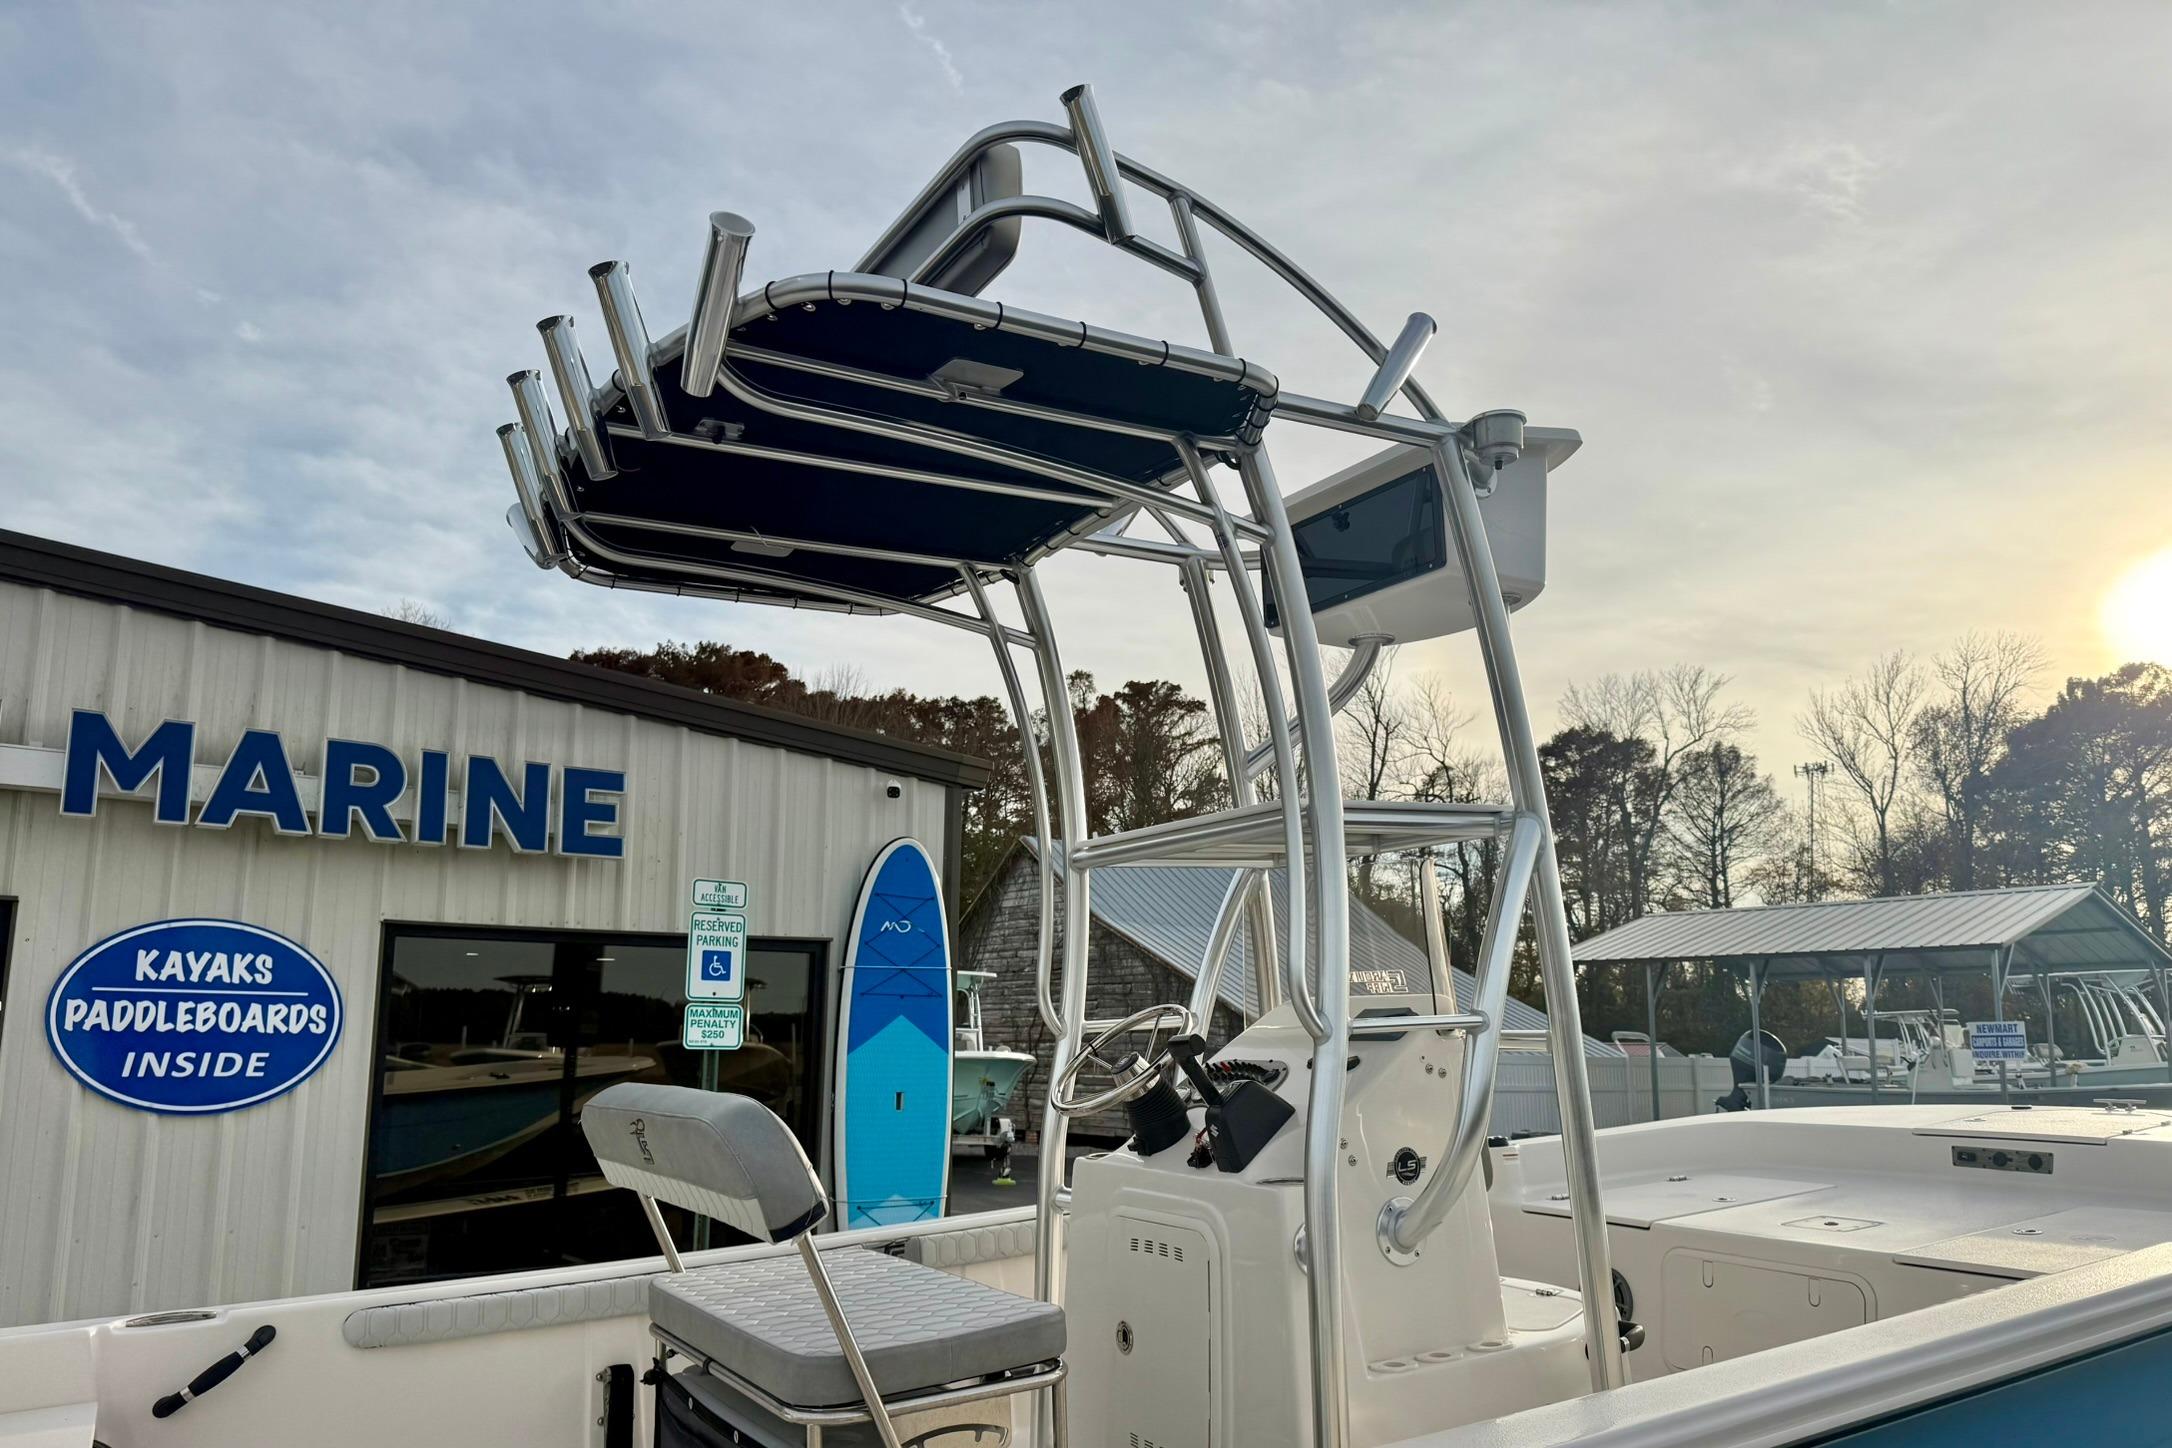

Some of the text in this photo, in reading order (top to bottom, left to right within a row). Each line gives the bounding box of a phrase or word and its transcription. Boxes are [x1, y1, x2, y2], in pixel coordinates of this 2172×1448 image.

[59, 708, 627, 860] MARINE
[714, 884, 726, 893] VAN
[700, 893, 739, 904] ACCESSIBLE
[694, 919, 742, 933] RESERVED
[696, 934, 739, 948] PARKING
[134, 948, 273, 985] KAYAKS
[63, 998, 328, 1036] PADDLEBOARDS
[690, 1008, 739, 1019] MAXIMUM
[690, 1019, 737, 1029] PENALTY
[1976, 1023, 2018, 1033] NEWMART
[701, 1029, 724, 1040] $250
[121, 1051, 270, 1078] INSIDE
[1398, 1159, 1417, 1172] LS
